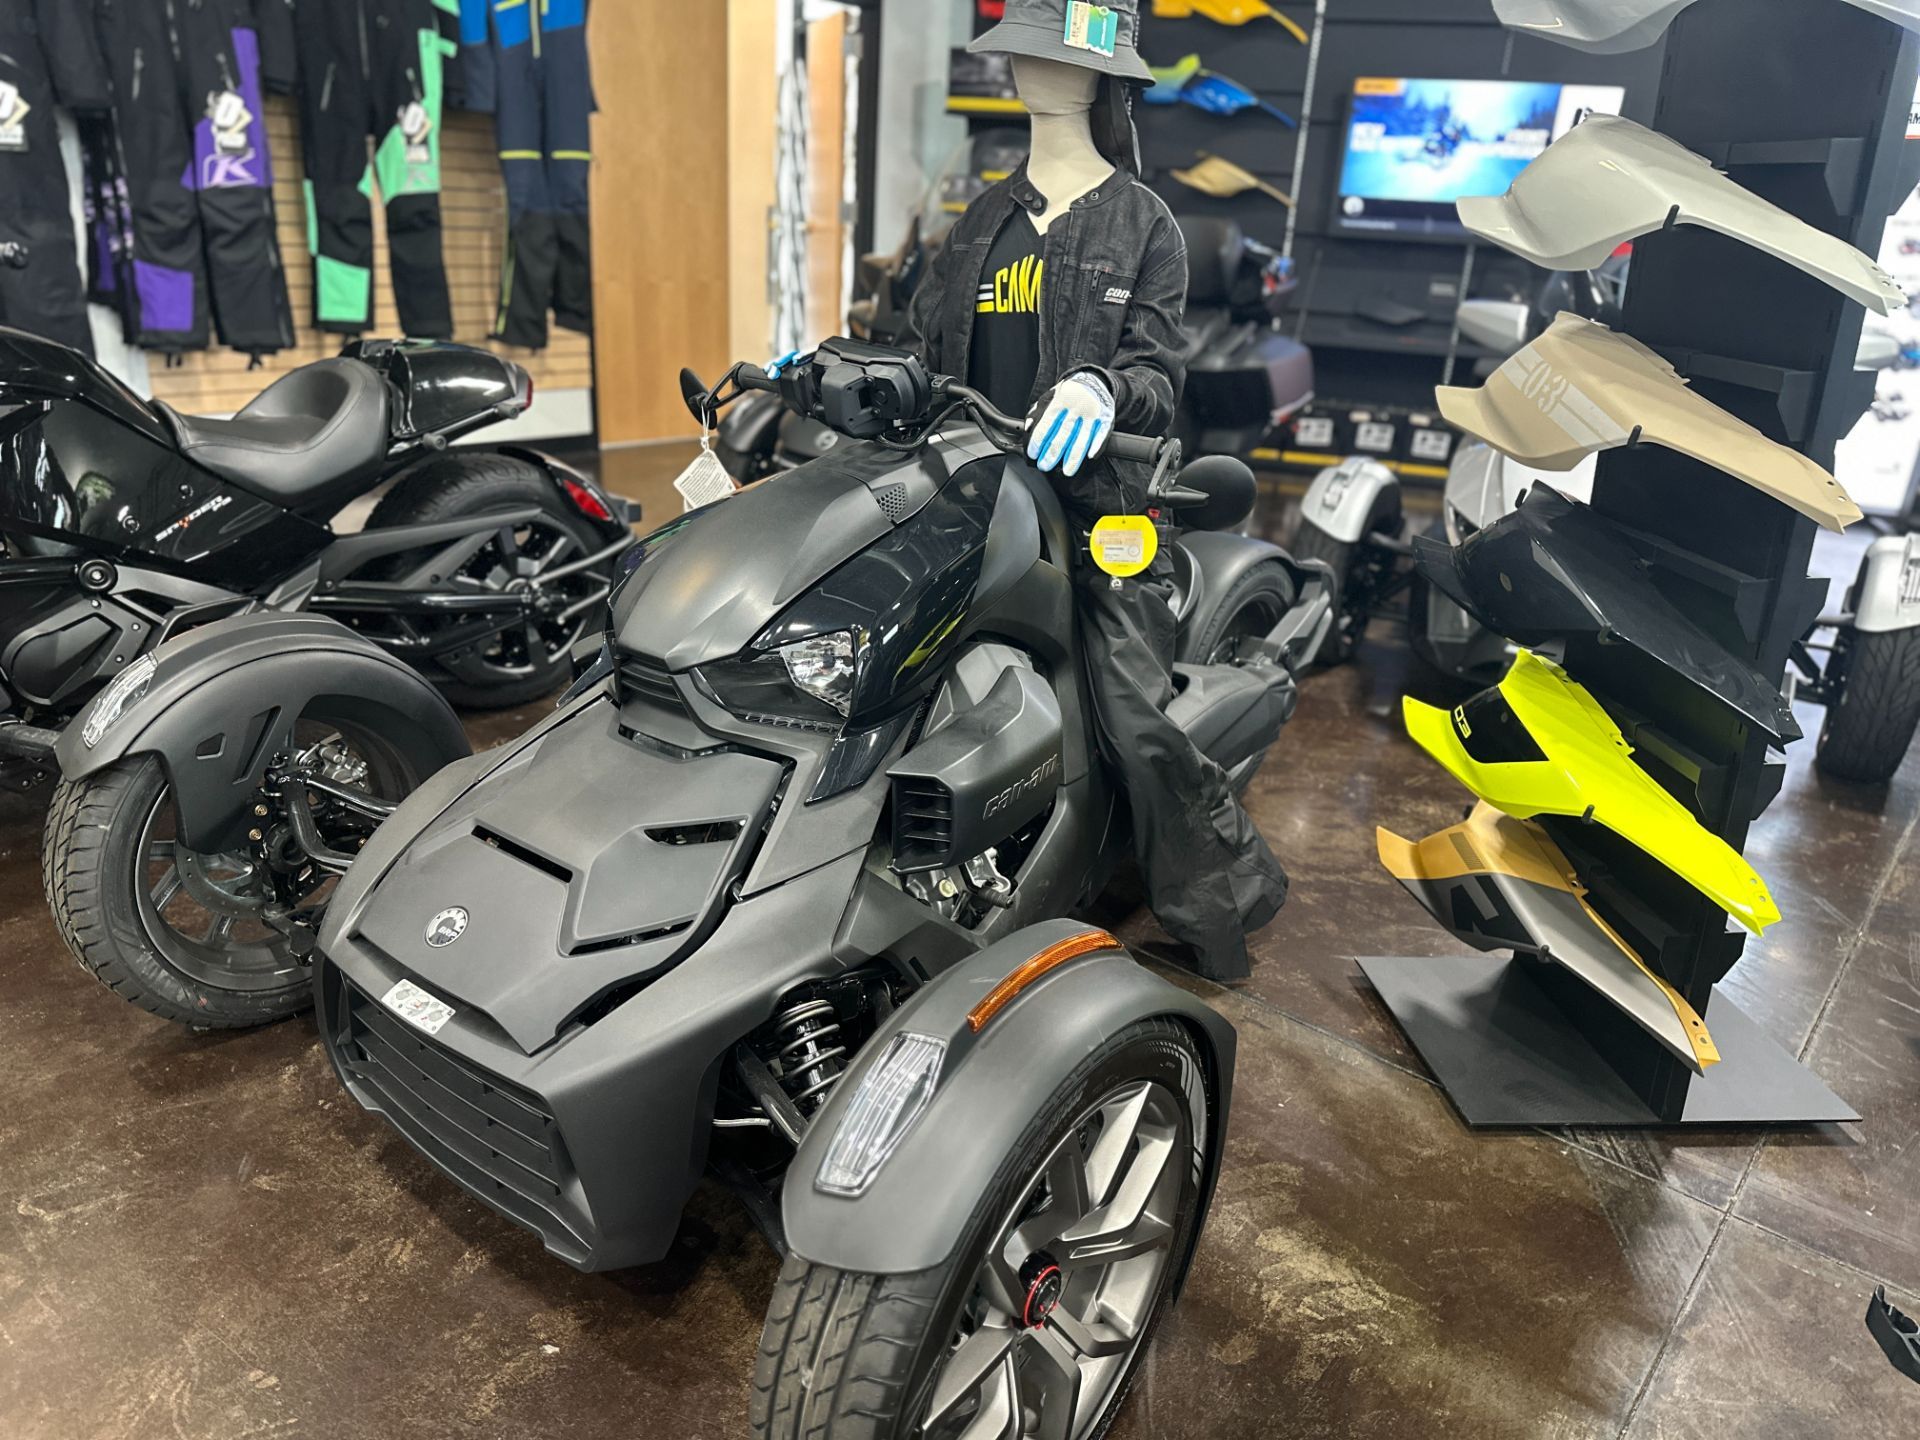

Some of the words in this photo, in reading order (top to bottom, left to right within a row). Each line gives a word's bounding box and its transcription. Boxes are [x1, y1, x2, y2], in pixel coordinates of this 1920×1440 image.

[1523, 361, 1568, 413] 03
[1453, 704, 1472, 739] 03
[982, 753, 1058, 820] can-am
